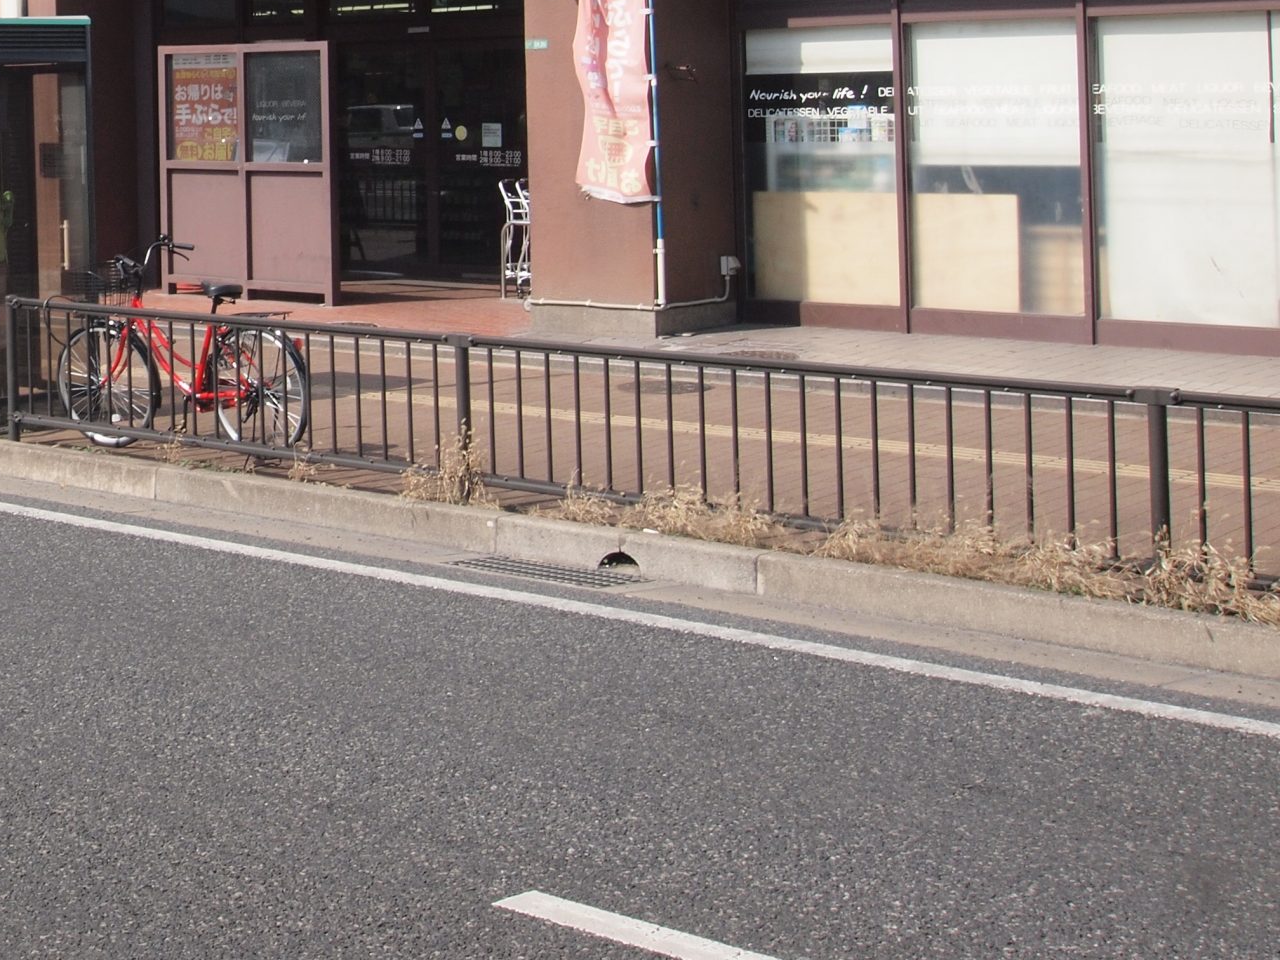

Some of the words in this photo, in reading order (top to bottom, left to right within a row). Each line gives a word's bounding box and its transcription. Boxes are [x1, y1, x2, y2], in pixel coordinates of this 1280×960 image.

[175, 83, 223, 101] お帰りは
[749, 88, 797, 101] Nourish
[832, 87, 856, 100] life
[748, 107, 819, 118] DELICATESSEN
